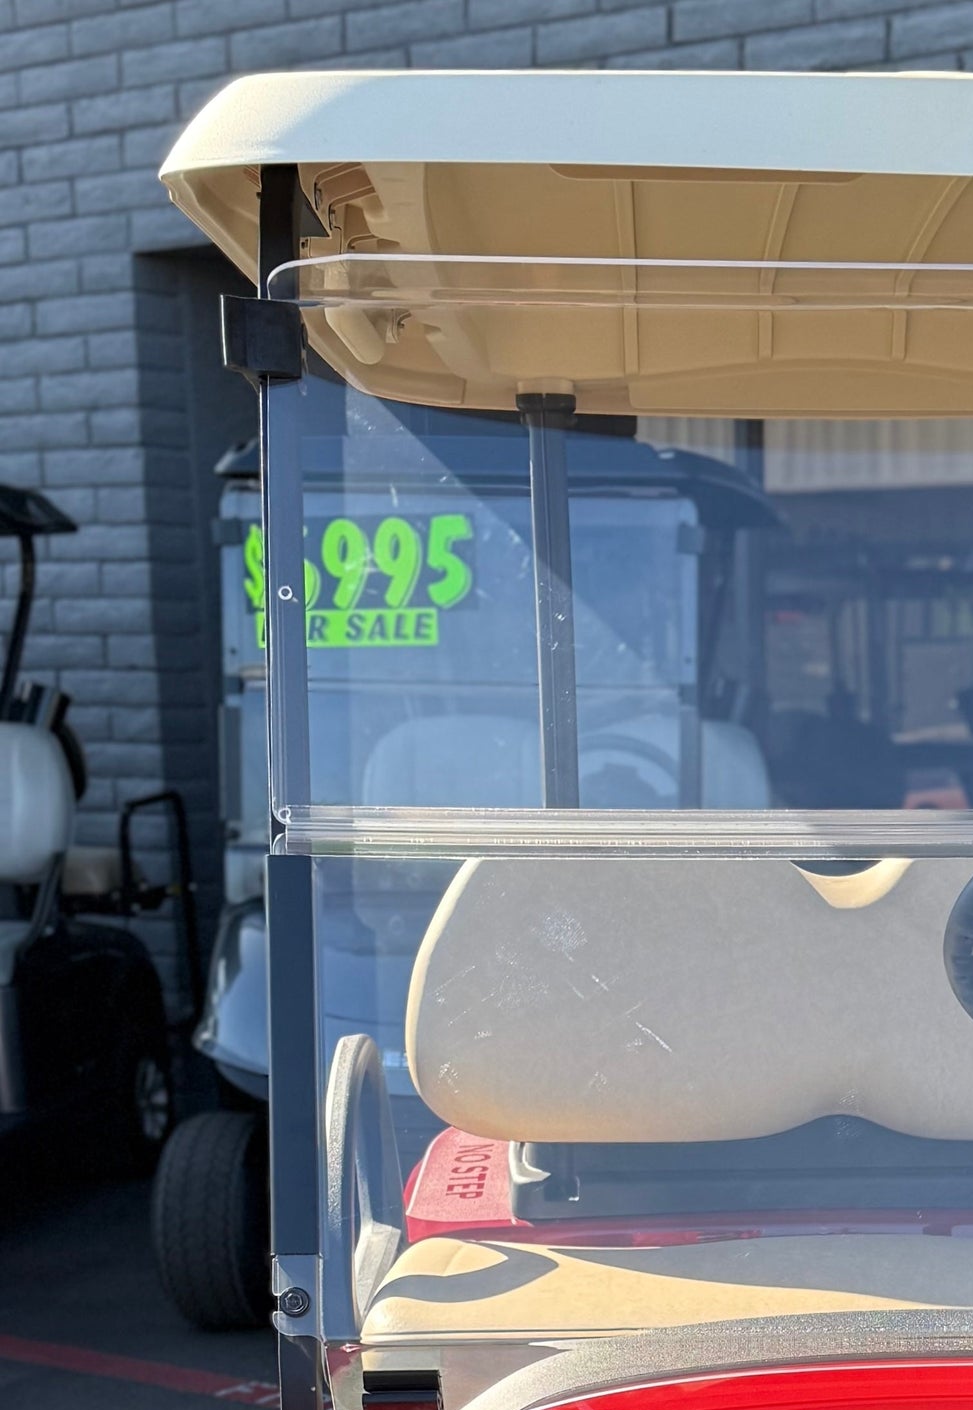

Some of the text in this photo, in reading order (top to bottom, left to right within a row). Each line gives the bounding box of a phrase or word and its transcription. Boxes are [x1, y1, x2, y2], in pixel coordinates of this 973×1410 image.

[345, 612, 435, 641] SALE
[445, 1143, 495, 1199] NO STEP
